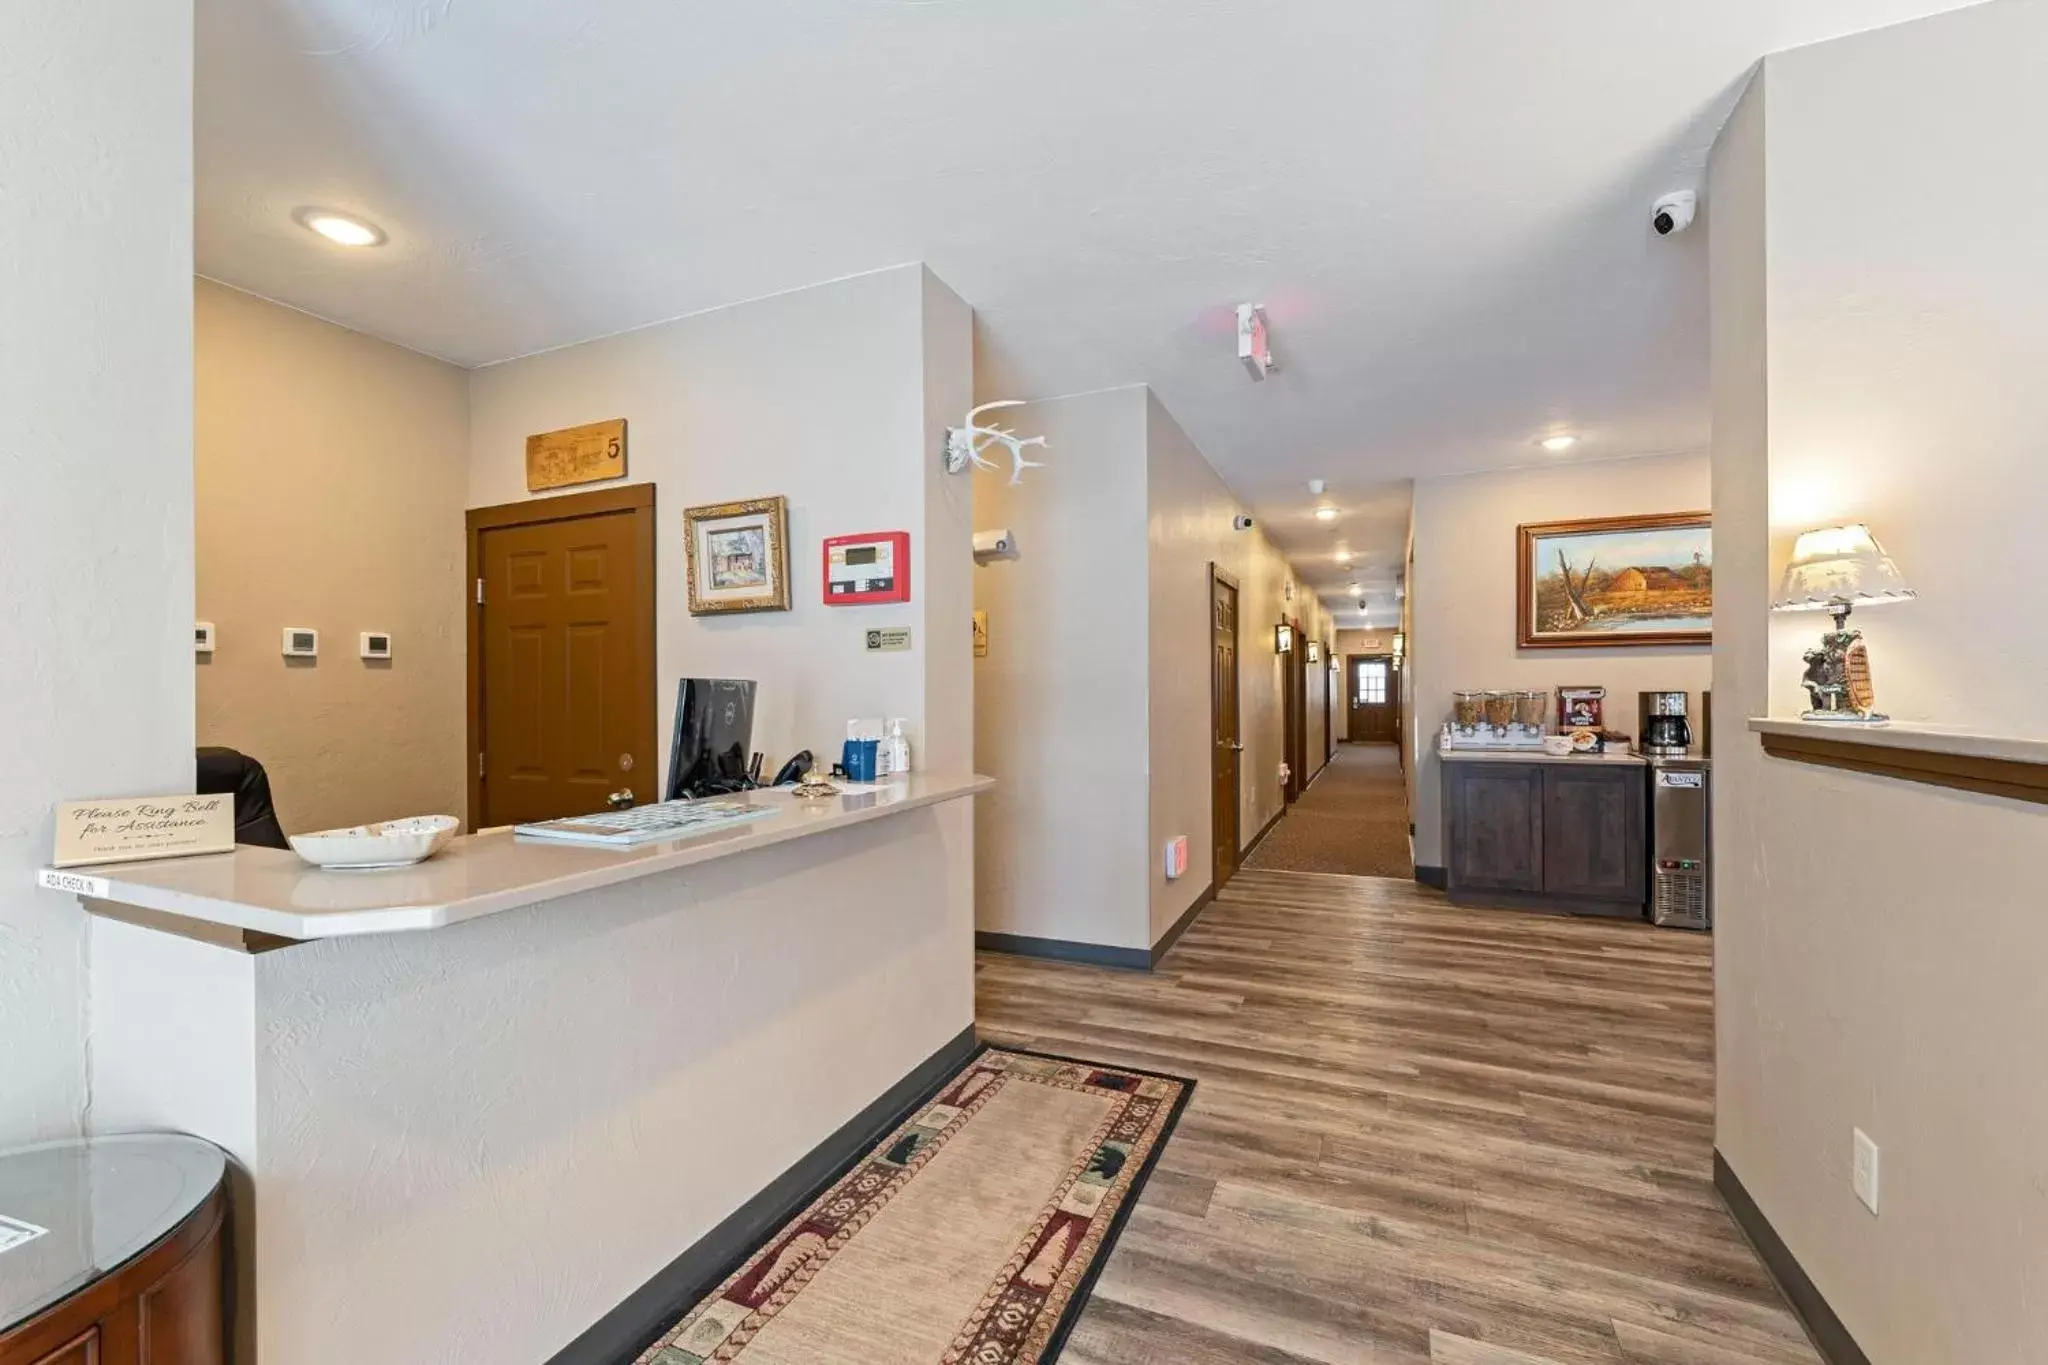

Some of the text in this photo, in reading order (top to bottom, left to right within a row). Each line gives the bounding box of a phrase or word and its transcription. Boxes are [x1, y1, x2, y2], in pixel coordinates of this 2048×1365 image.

[607, 437, 620, 459] 5
[73, 800, 220, 820] Please Ring Bell
[80, 820, 206, 840] for Assistance
[46, 873, 61, 887] ADA
[62, 876, 85, 891] CHECK
